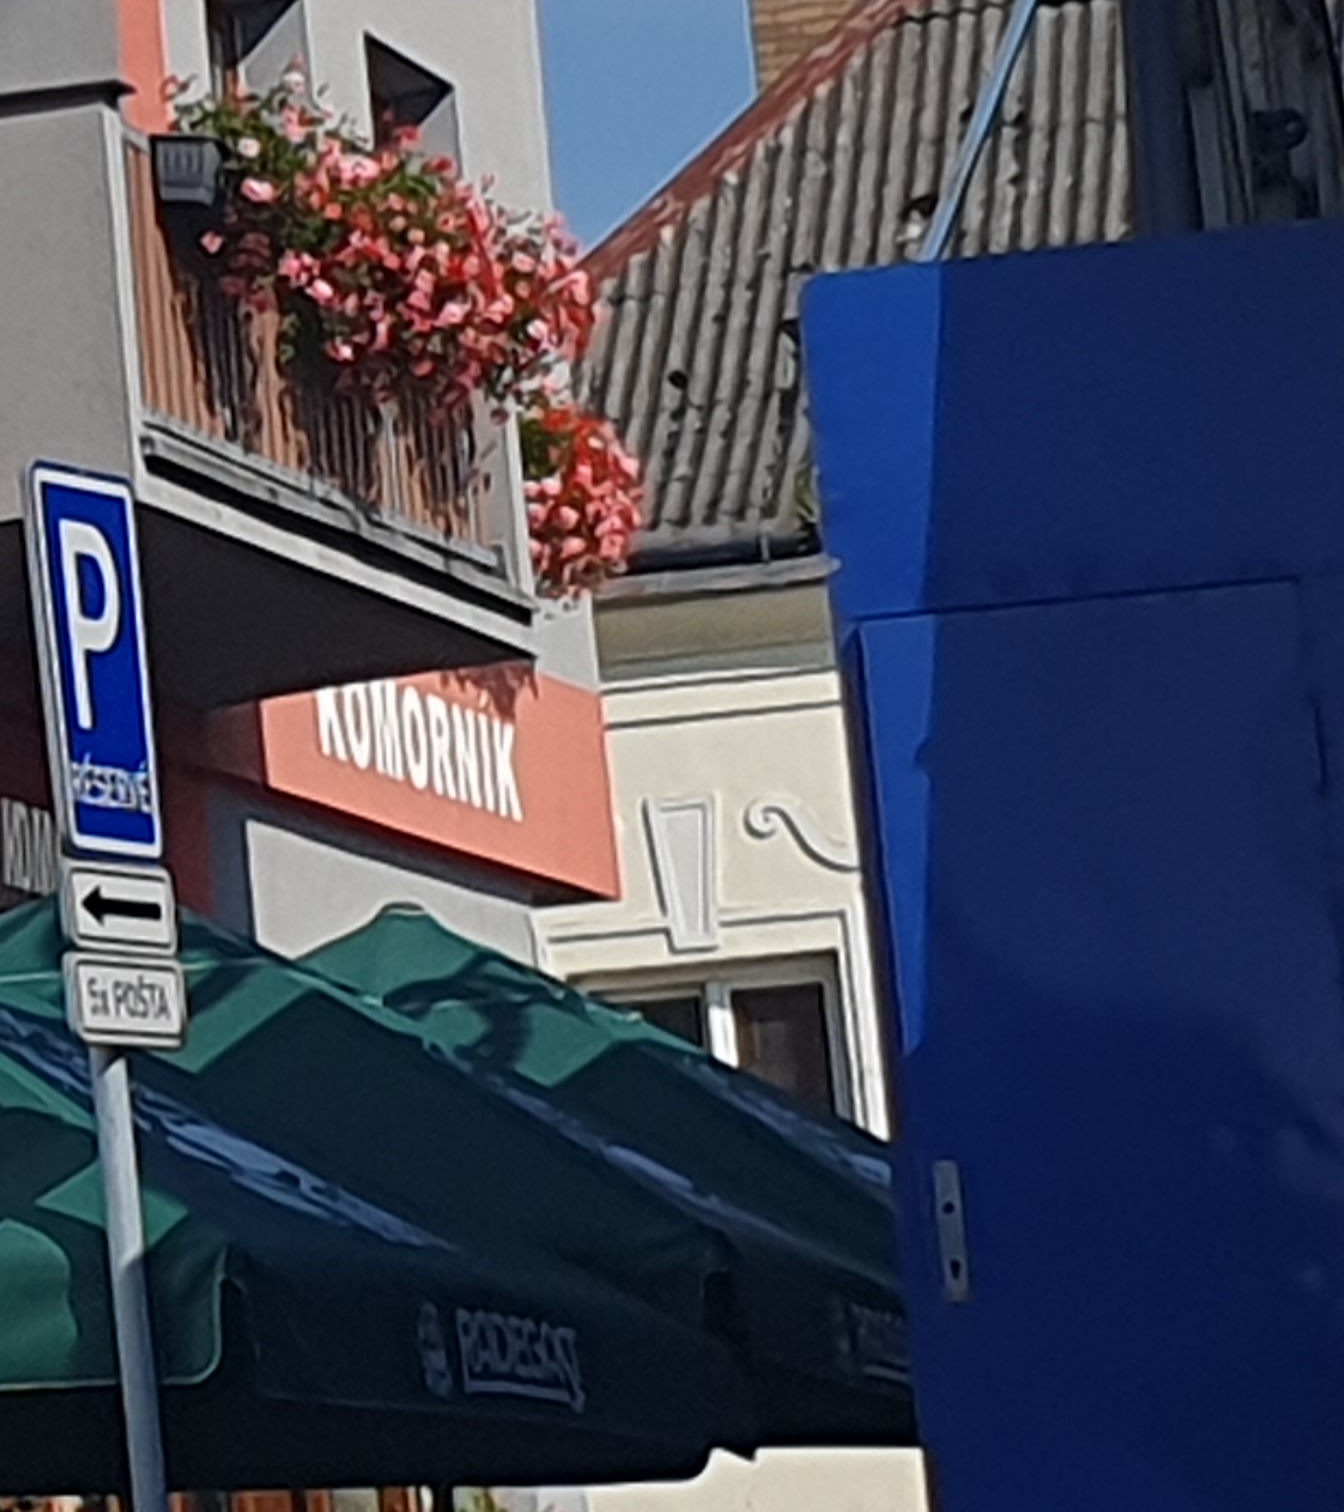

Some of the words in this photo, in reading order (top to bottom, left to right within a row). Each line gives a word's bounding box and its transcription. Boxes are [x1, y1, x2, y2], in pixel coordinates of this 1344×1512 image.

[58, 519, 120, 730] P
[316, 680, 523, 822] KOMORNÍK
[113, 975, 171, 1019] POŠTA
